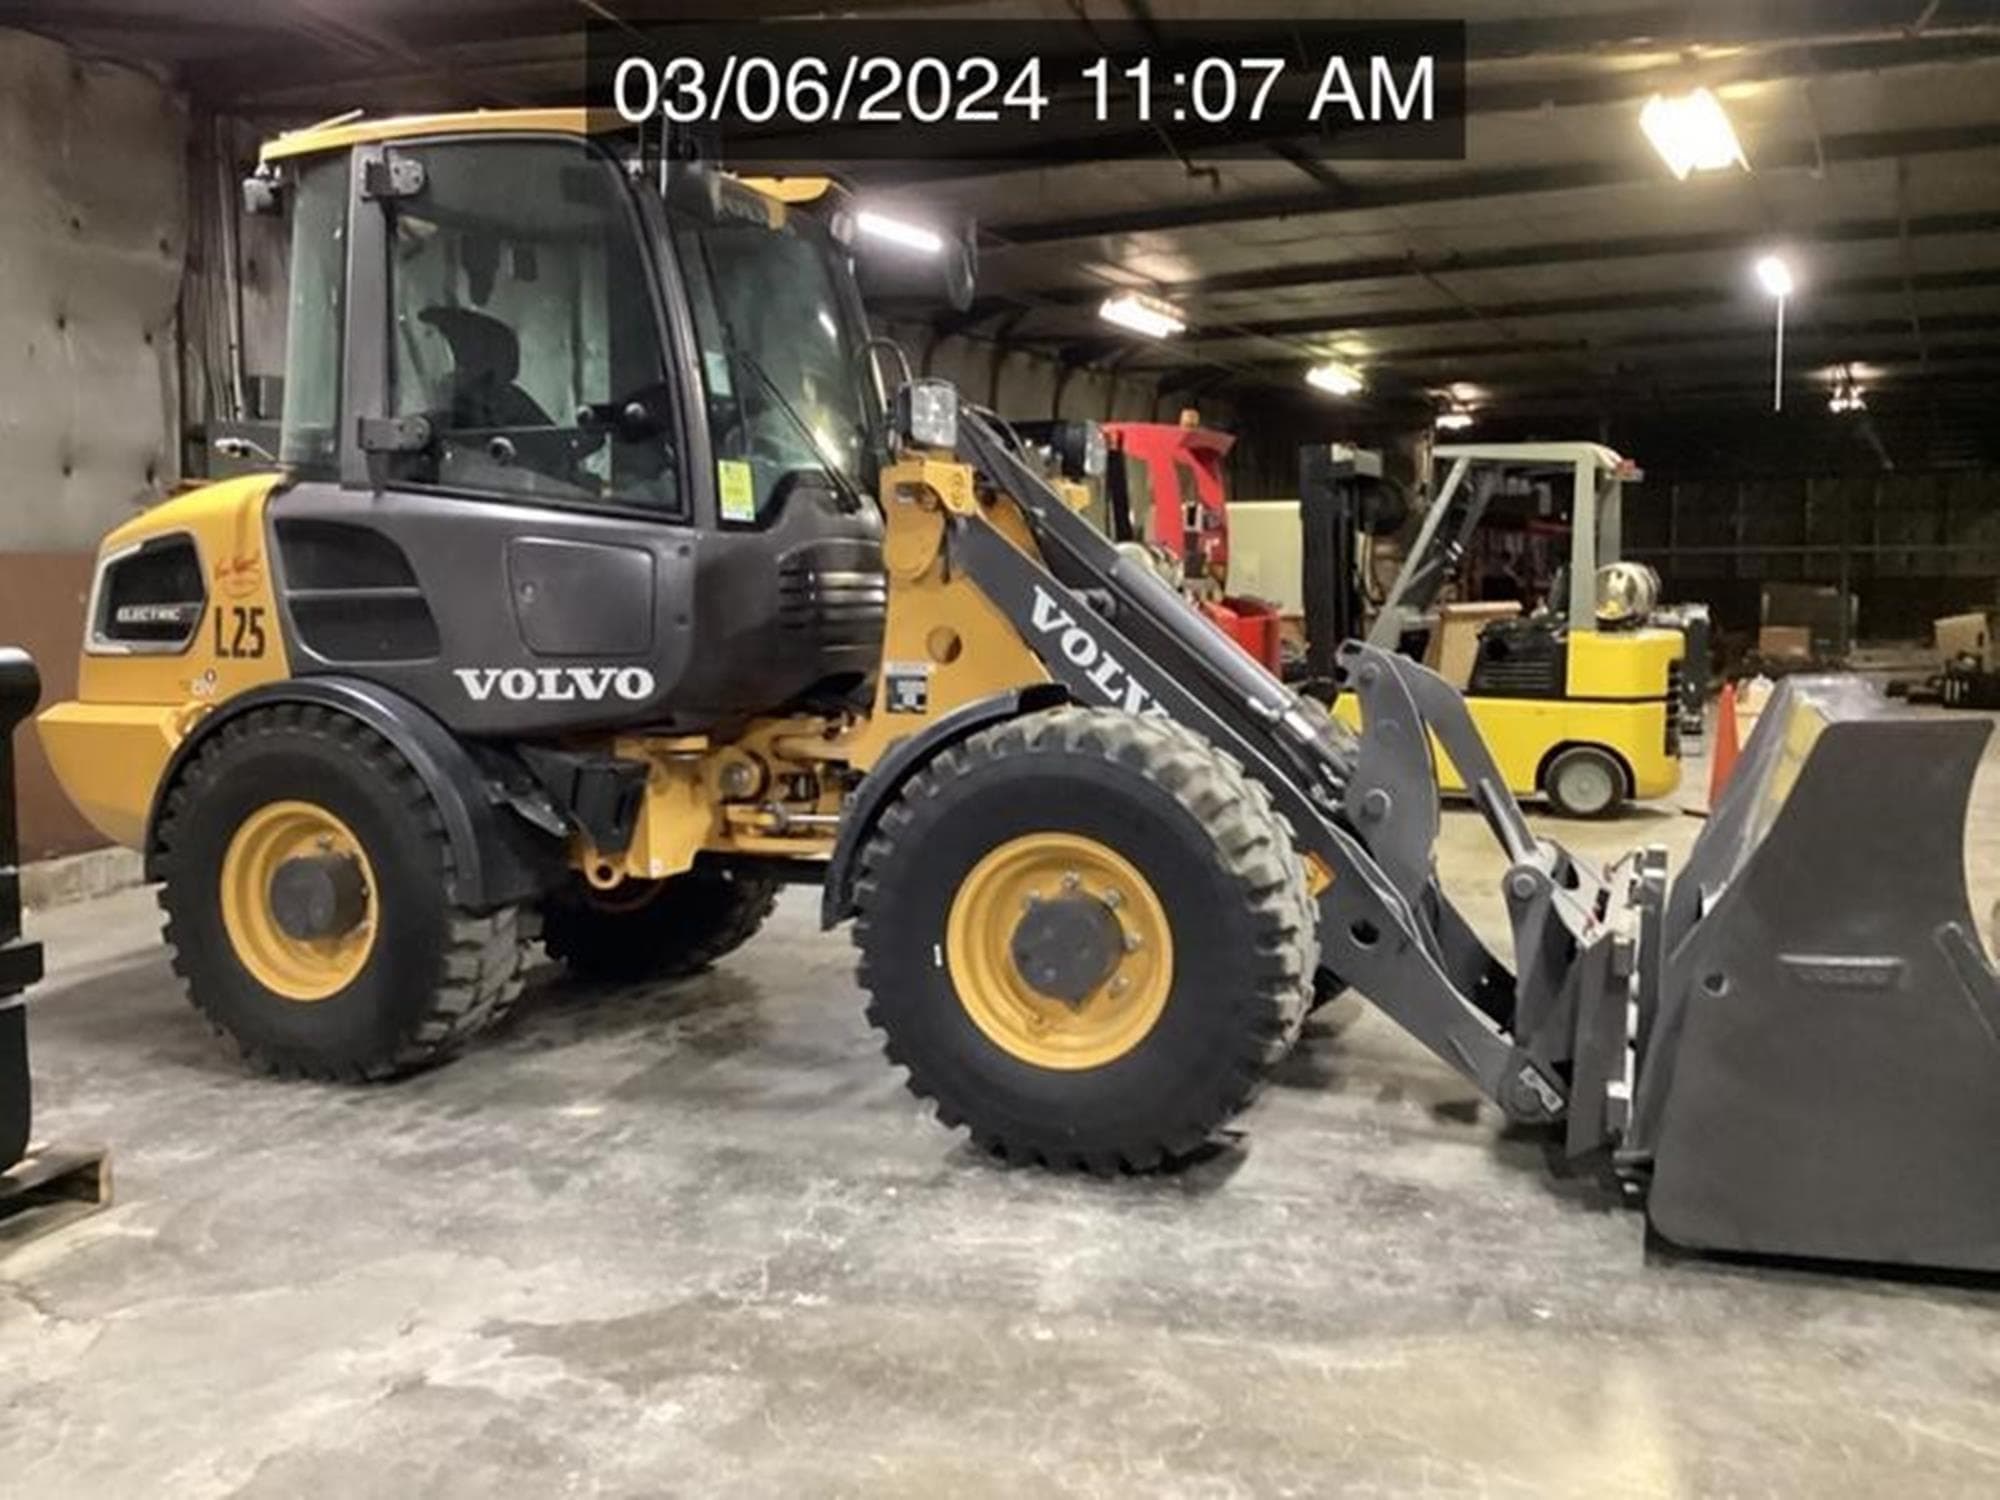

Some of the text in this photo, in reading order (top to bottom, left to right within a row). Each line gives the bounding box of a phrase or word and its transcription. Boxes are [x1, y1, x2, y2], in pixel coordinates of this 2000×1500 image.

[215, 606, 265, 658] L25
[1031, 584, 1170, 717] VOLV
[453, 667, 655, 700] VOLVO
